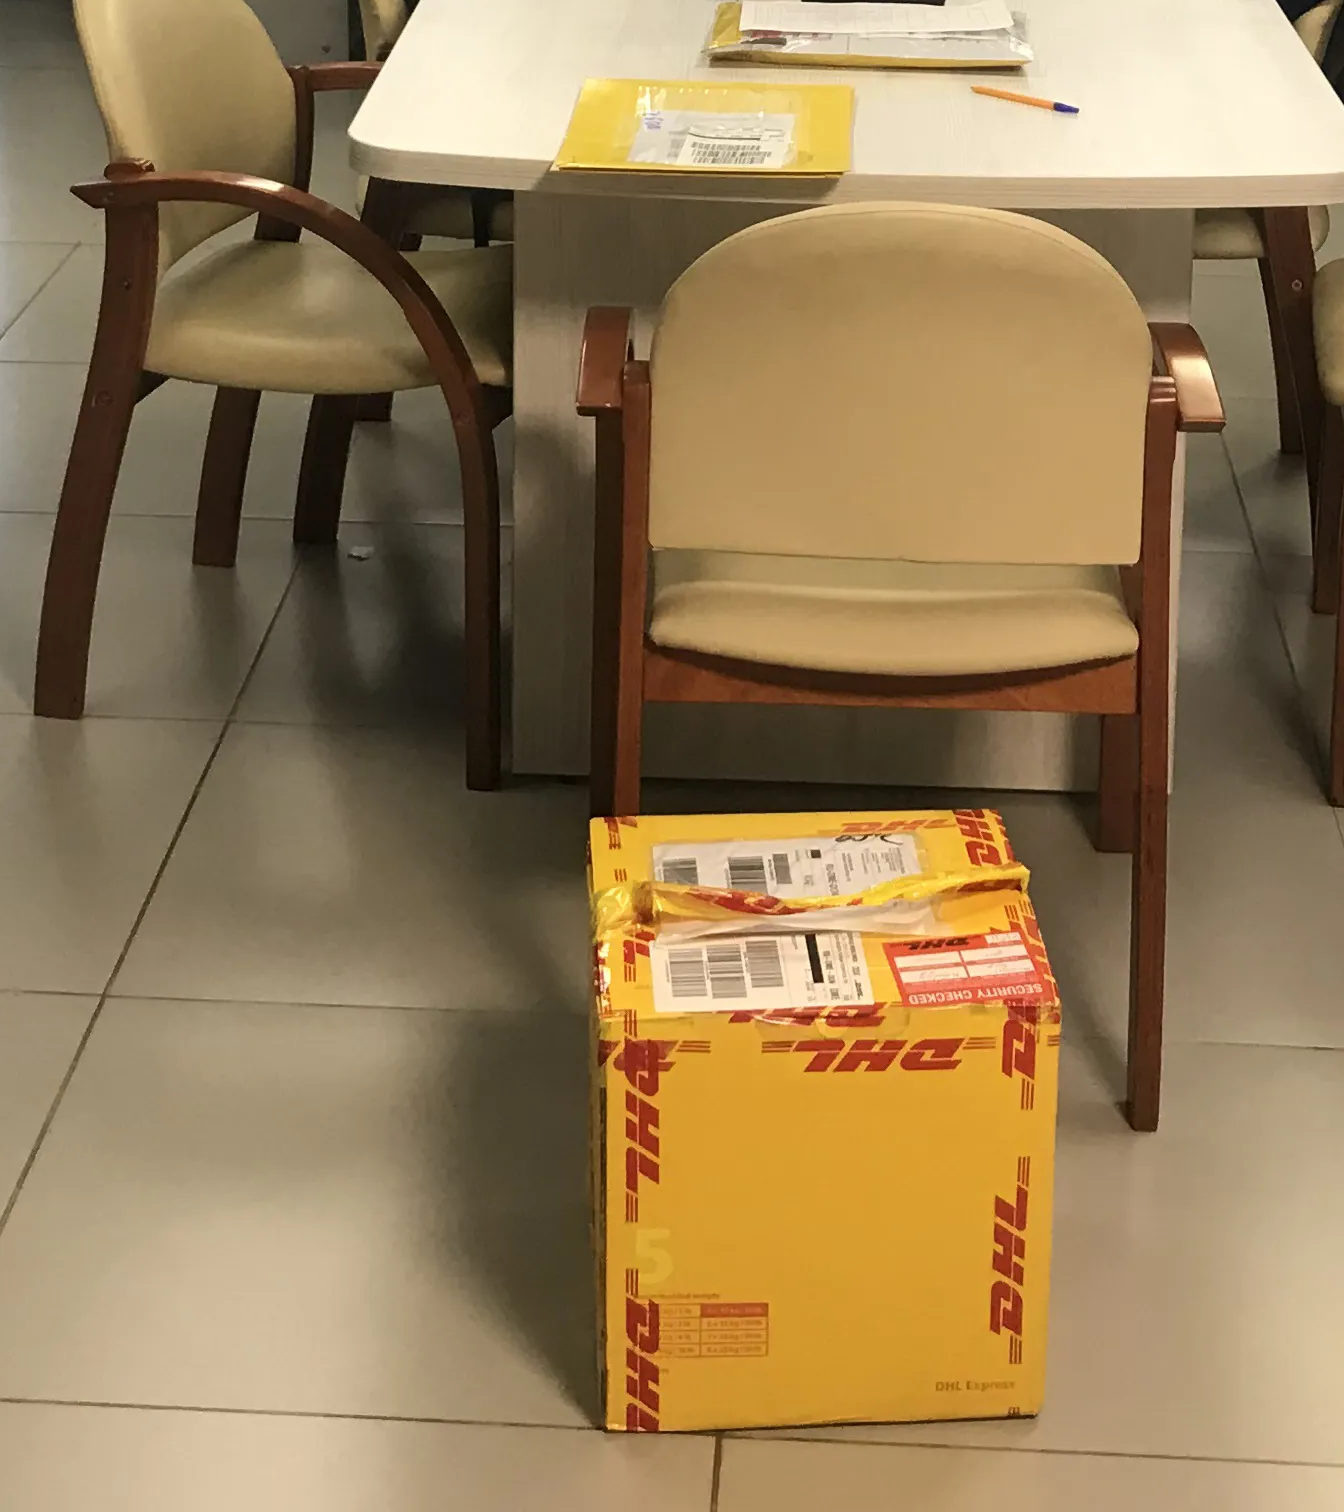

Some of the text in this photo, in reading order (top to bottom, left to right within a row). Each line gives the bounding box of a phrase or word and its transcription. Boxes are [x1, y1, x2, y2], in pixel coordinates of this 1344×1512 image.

[908, 983, 1044, 1005] SECURITY CHECKED
[793, 1038, 966, 1073] DHL
[989, 1184, 1029, 1337] DHL
[935, 1381, 962, 1393] DHL
